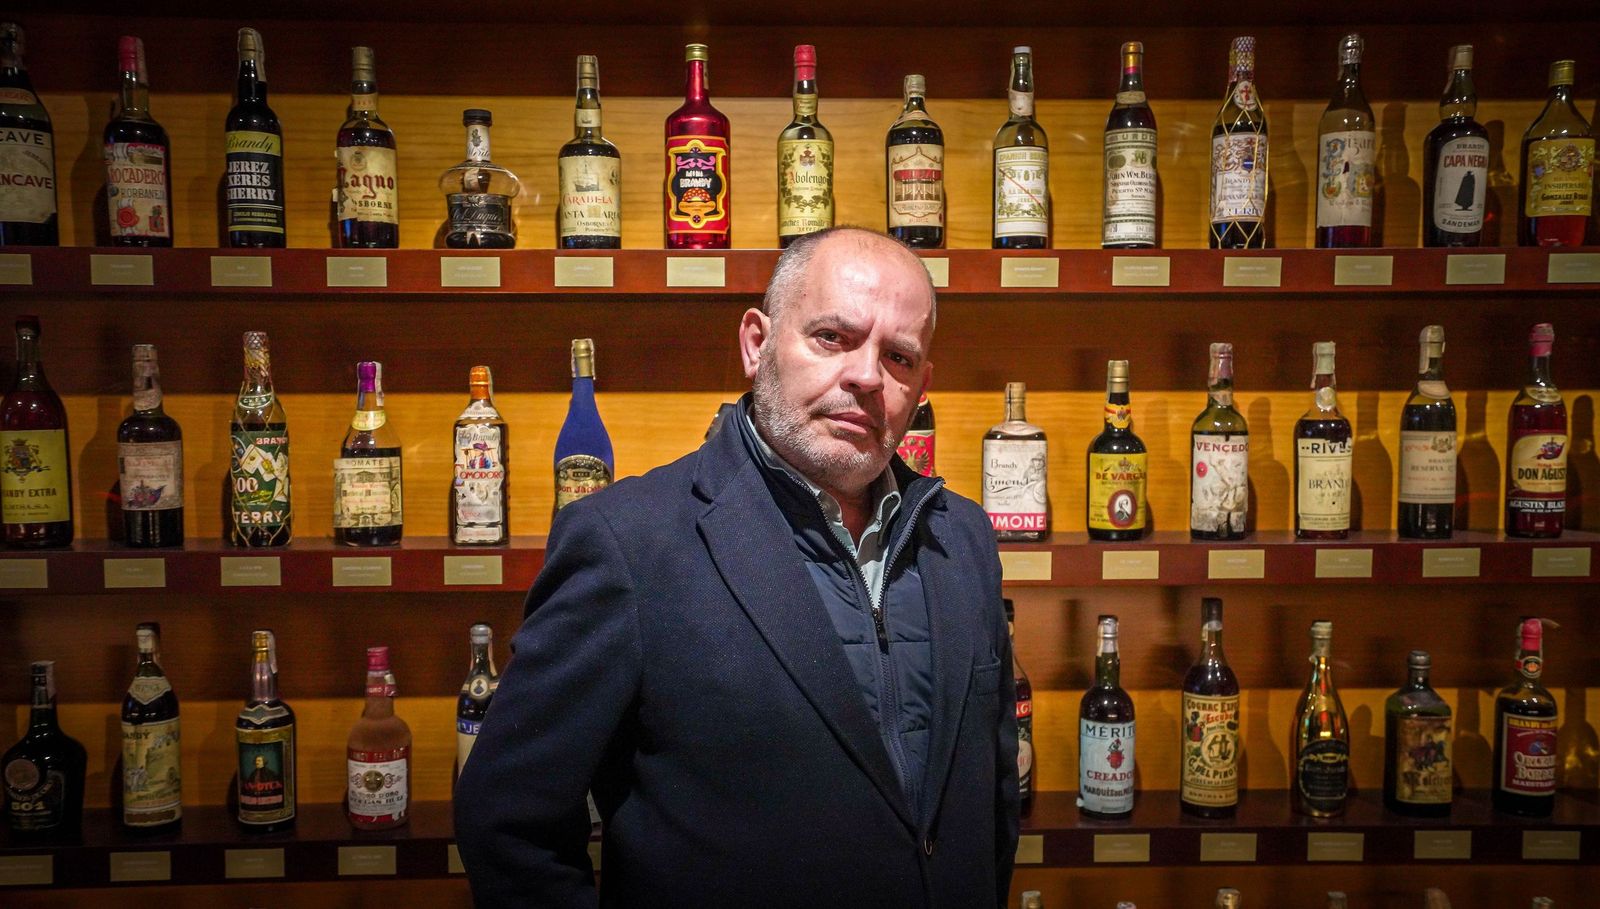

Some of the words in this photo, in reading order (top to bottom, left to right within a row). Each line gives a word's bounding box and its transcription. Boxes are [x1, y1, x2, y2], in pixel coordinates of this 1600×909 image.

[228, 136, 274, 153] Brandy
[228, 161, 270, 174] JEREZ
[1443, 154, 1465, 169] CAPA
[679, 178, 712, 189] BRANDY
[1518, 467, 1539, 480] DON
[28, 487, 57, 498] EXTRA
